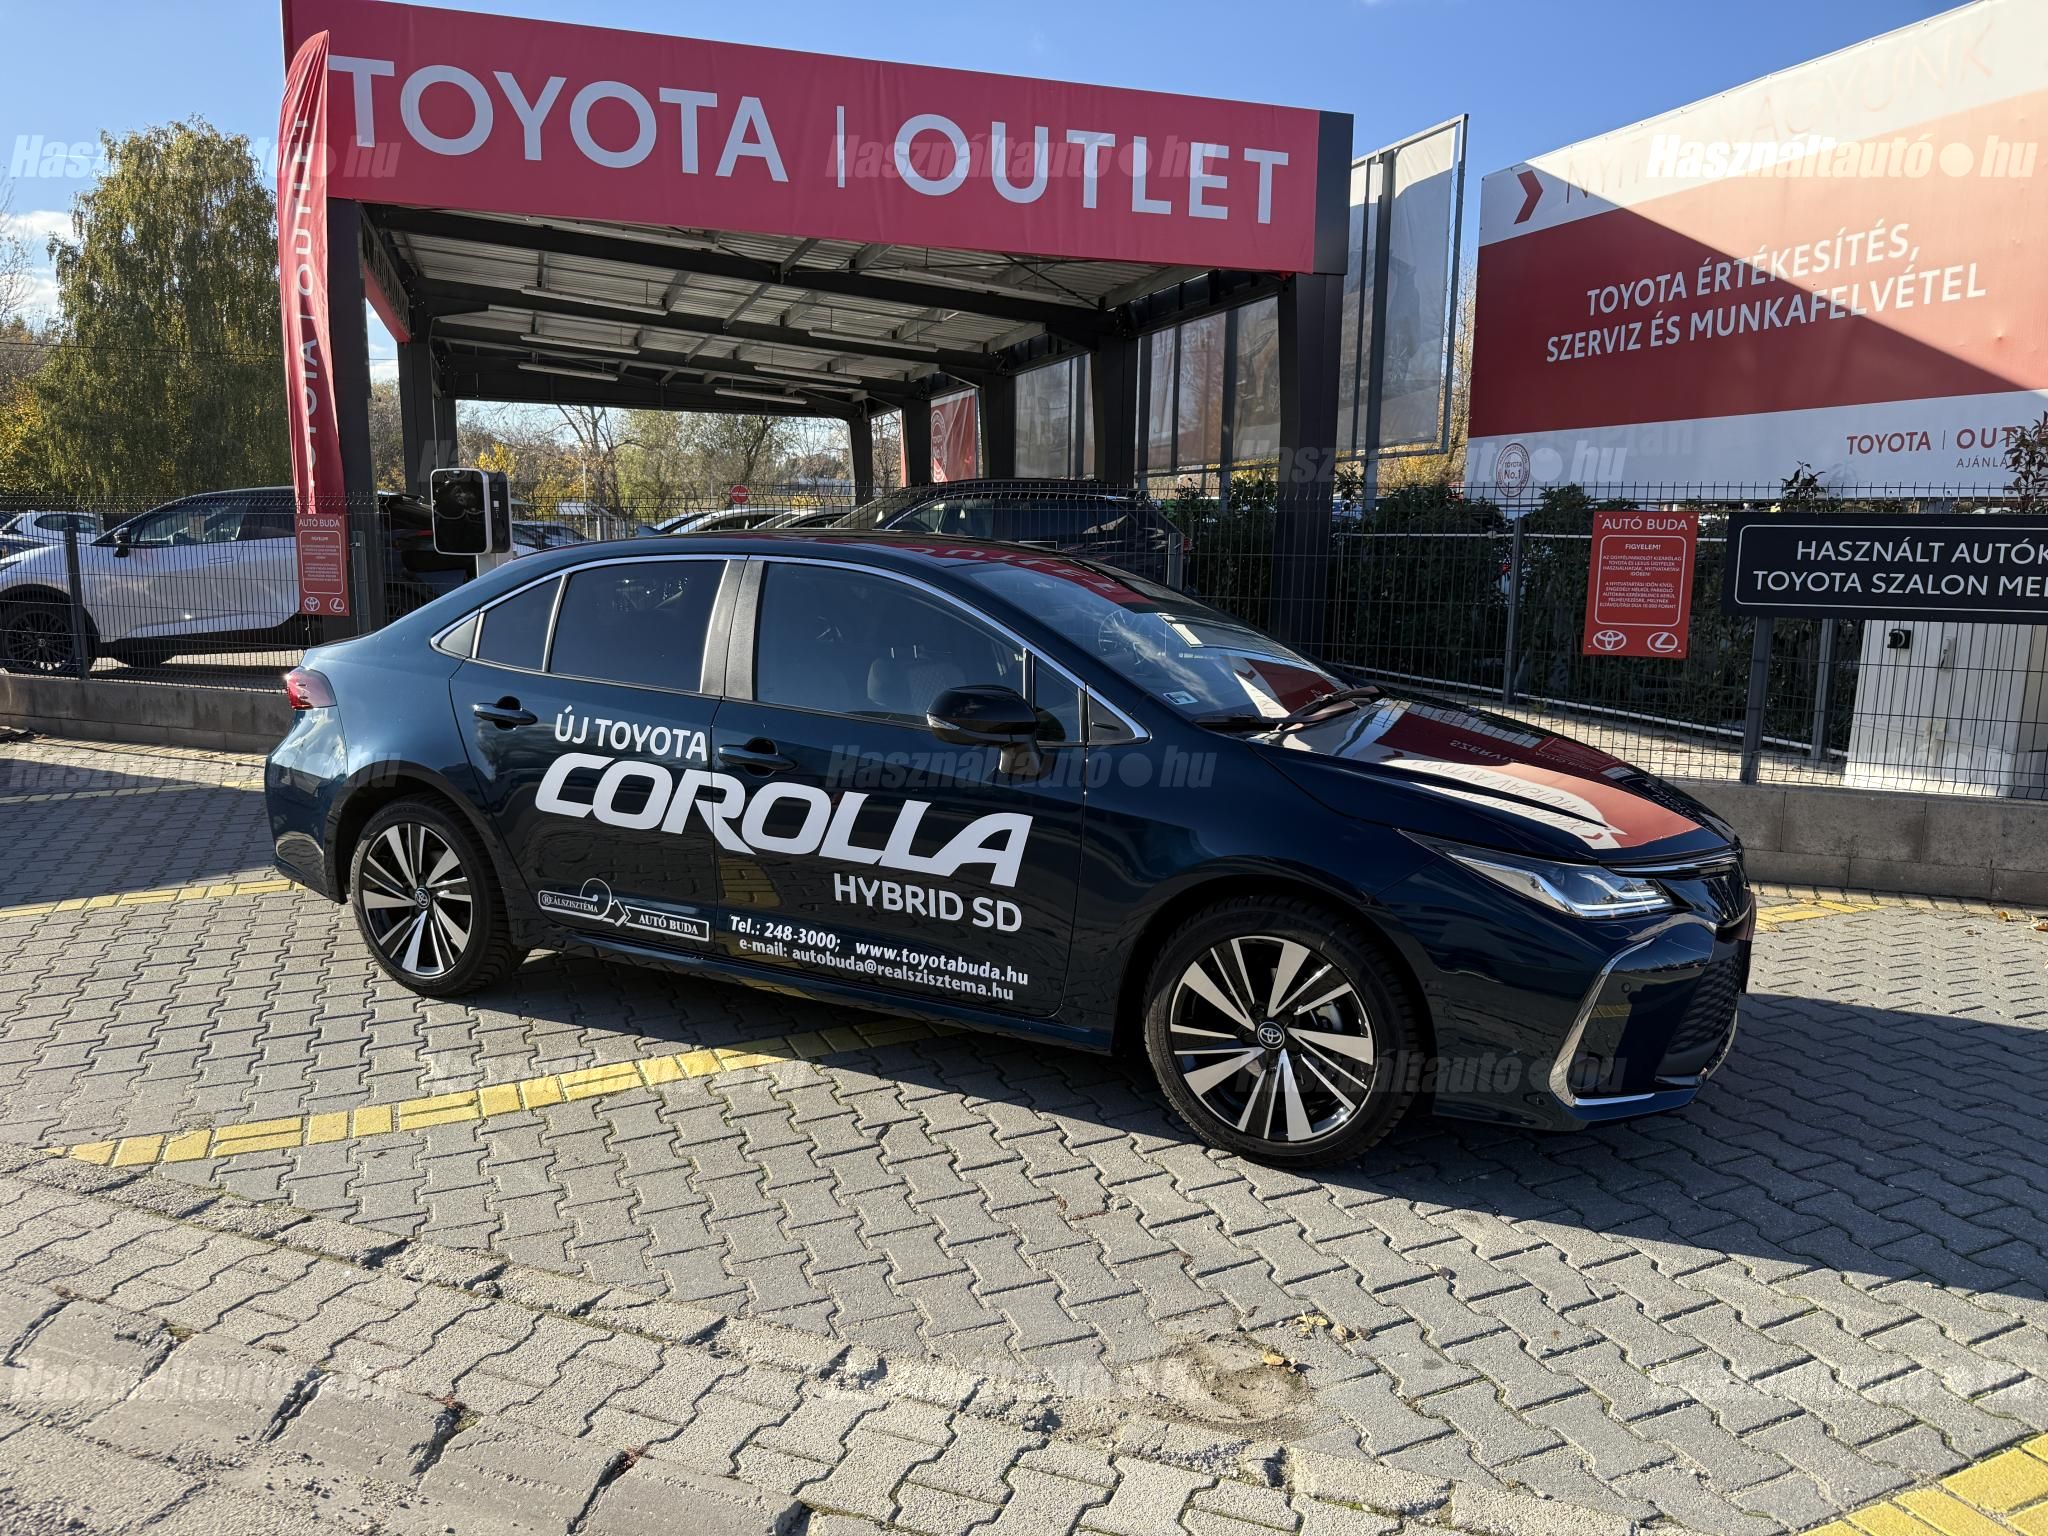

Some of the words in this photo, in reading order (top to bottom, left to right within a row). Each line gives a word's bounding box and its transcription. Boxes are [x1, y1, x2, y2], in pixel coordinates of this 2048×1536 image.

[328, 54, 789, 183] TOYOTA
[893, 113, 1290, 225] OUTLET
[1587, 272, 1687, 316] TOYOTA
[1696, 218, 1921, 294] ÉRTÉKESÍTÉS,
[1546, 321, 1642, 363] SZERVIZ
[1650, 310, 1681, 348] ÉS
[1690, 262, 1986, 342] MUNKAFELVÉTEL
[1846, 430, 1932, 456] TOYOTA
[1956, 425, 2030, 450] OUT
[1504, 469, 1521, 480] No.1
[1956, 455, 2010, 469] AJÁNLÁ
[299, 518, 318, 528] AUTÓ
[319, 519, 340, 528] BUDA
[1602, 516, 1643, 531] AUTÓ
[1646, 518, 1688, 531] BUDA
[1625, 543, 1661, 551] FIGYELEM!
[1797, 537, 1945, 563] HASZNÁLT
[1753, 570, 1862, 593] TOYOTA
[1871, 572, 1988, 596] SZALON
[554, 704, 588, 746] ÚJ
[594, 718, 708, 762] TOYOTA
[535, 751, 1034, 888] COROLLA
[834, 873, 964, 922] HYBRID
[972, 896, 1023, 932] SD
[638, 915, 667, 928] AUTÓ
[669, 921, 699, 936] BUDA
[730, 915, 761, 937] Tel.:
[765, 921, 842, 953] 248-3000;
[855, 942, 1029, 986] www.toyotabuda.hu
[739, 938, 788, 960] e-mail:
[791, 947, 1014, 1001] autobuda@realszisztema.hu
